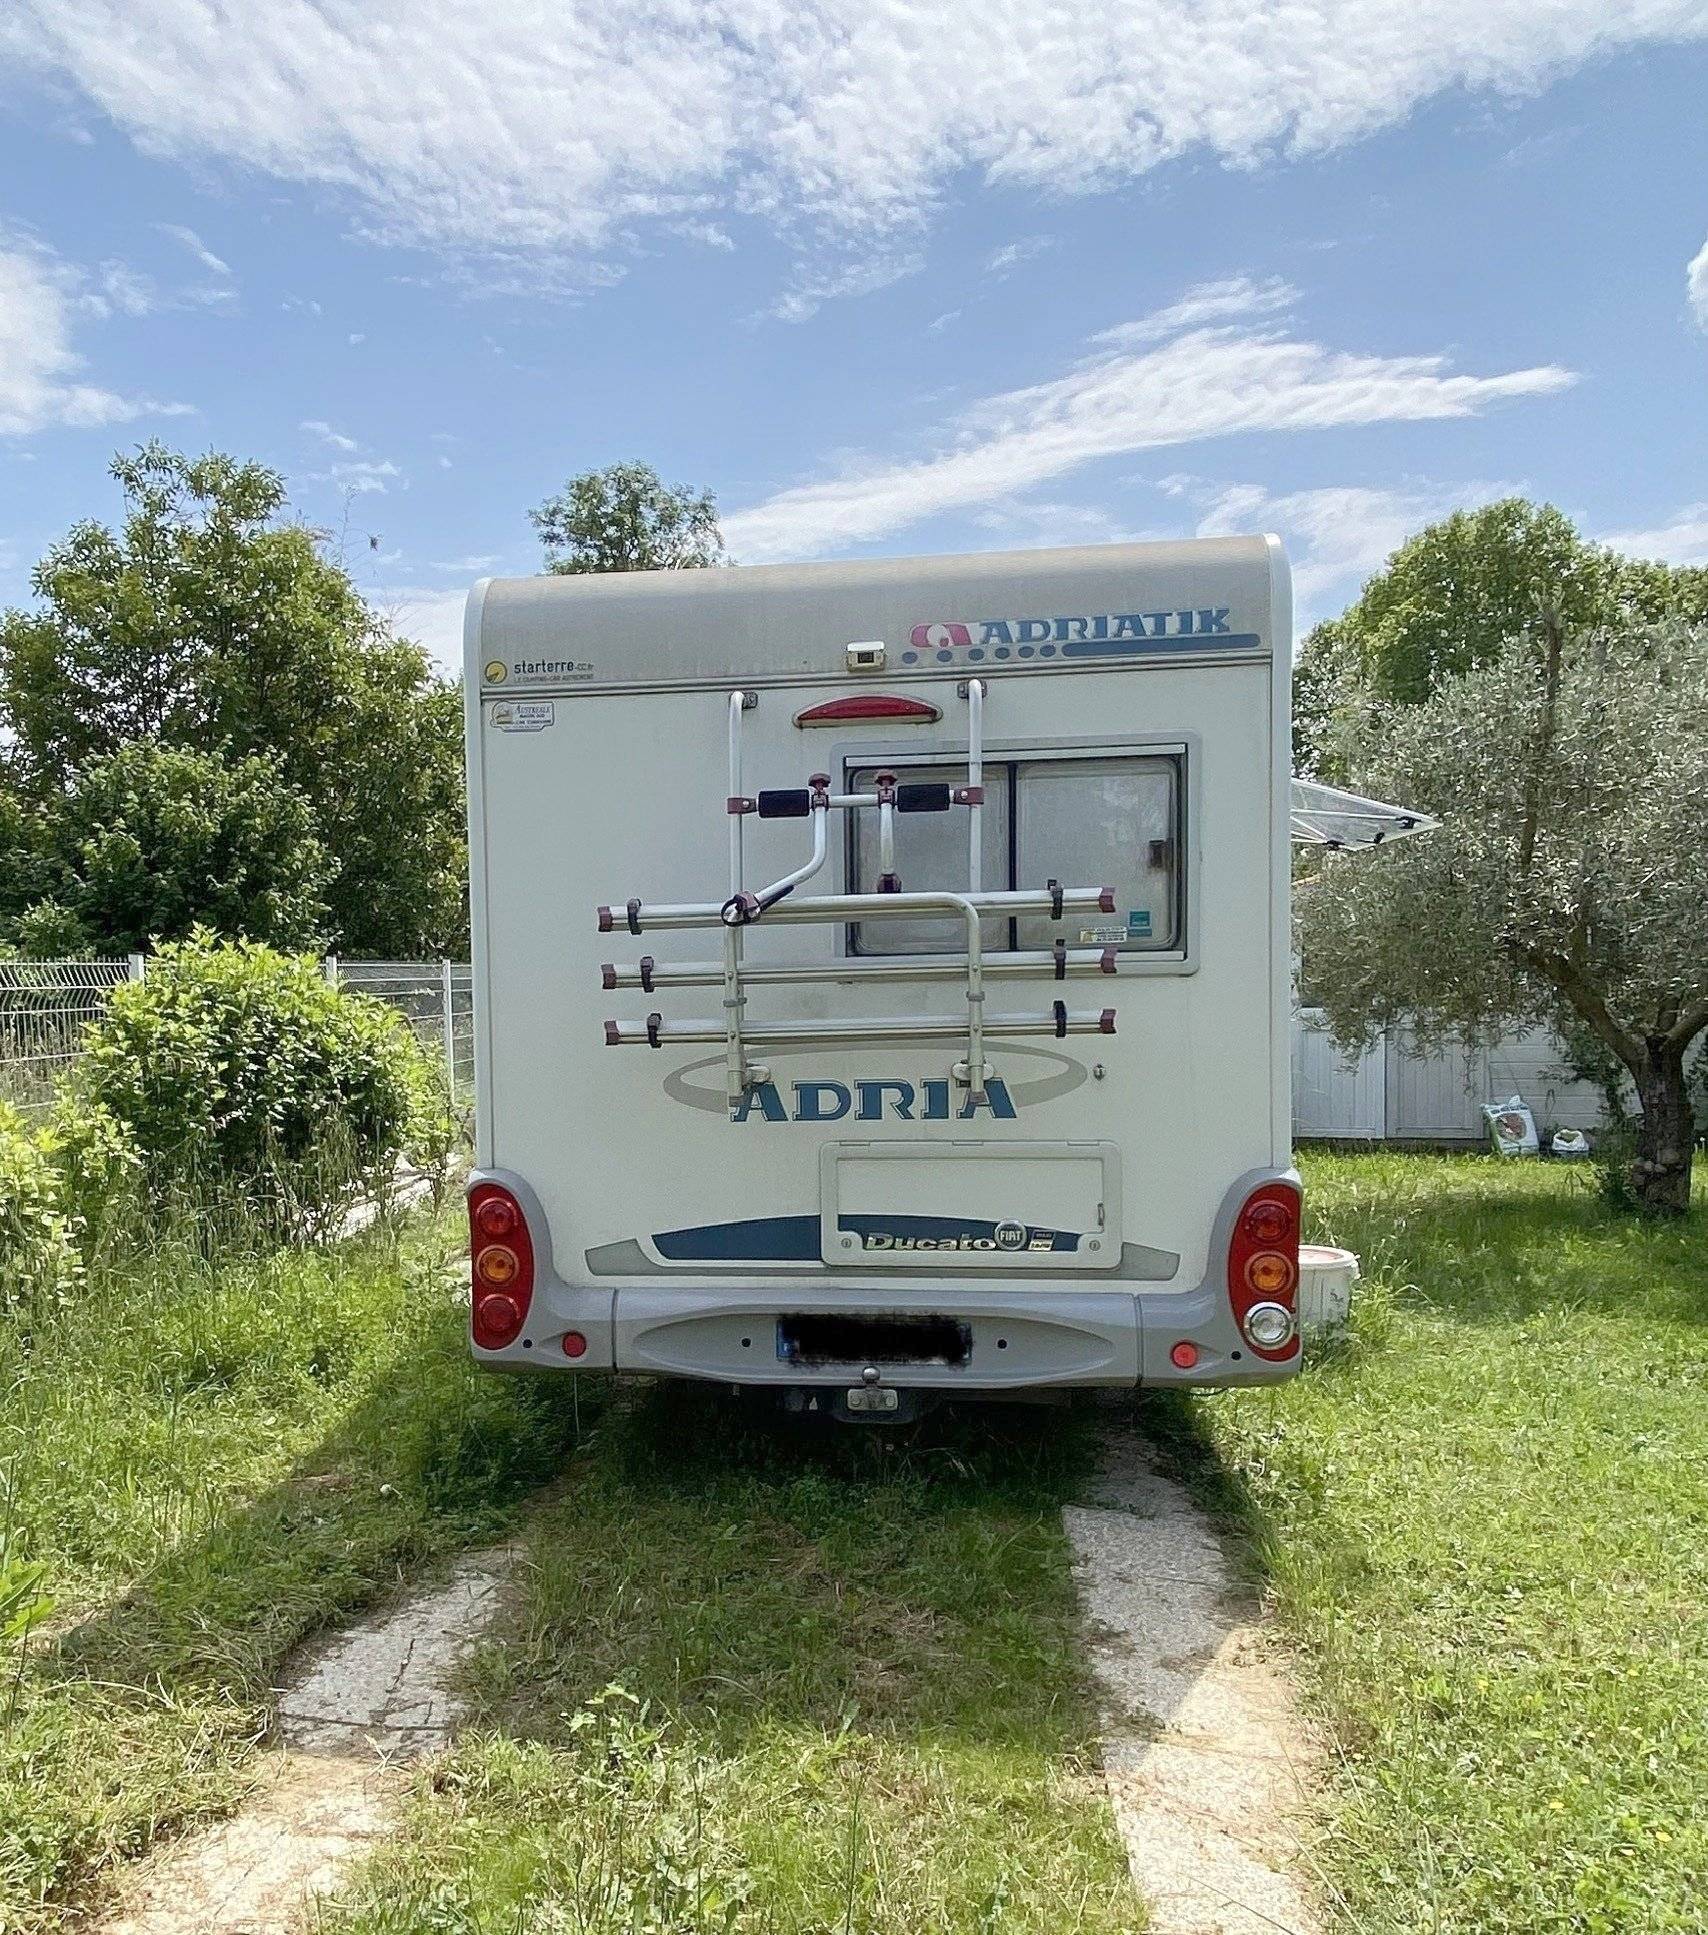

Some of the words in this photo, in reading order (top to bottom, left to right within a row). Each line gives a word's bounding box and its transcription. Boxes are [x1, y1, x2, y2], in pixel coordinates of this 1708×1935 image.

[979, 608, 1231, 645] ADRIATIK
[731, 1078, 1017, 1122] ADRIA
[864, 1232, 996, 1251] Ducato
[1000, 1230, 1022, 1241] FIAT
